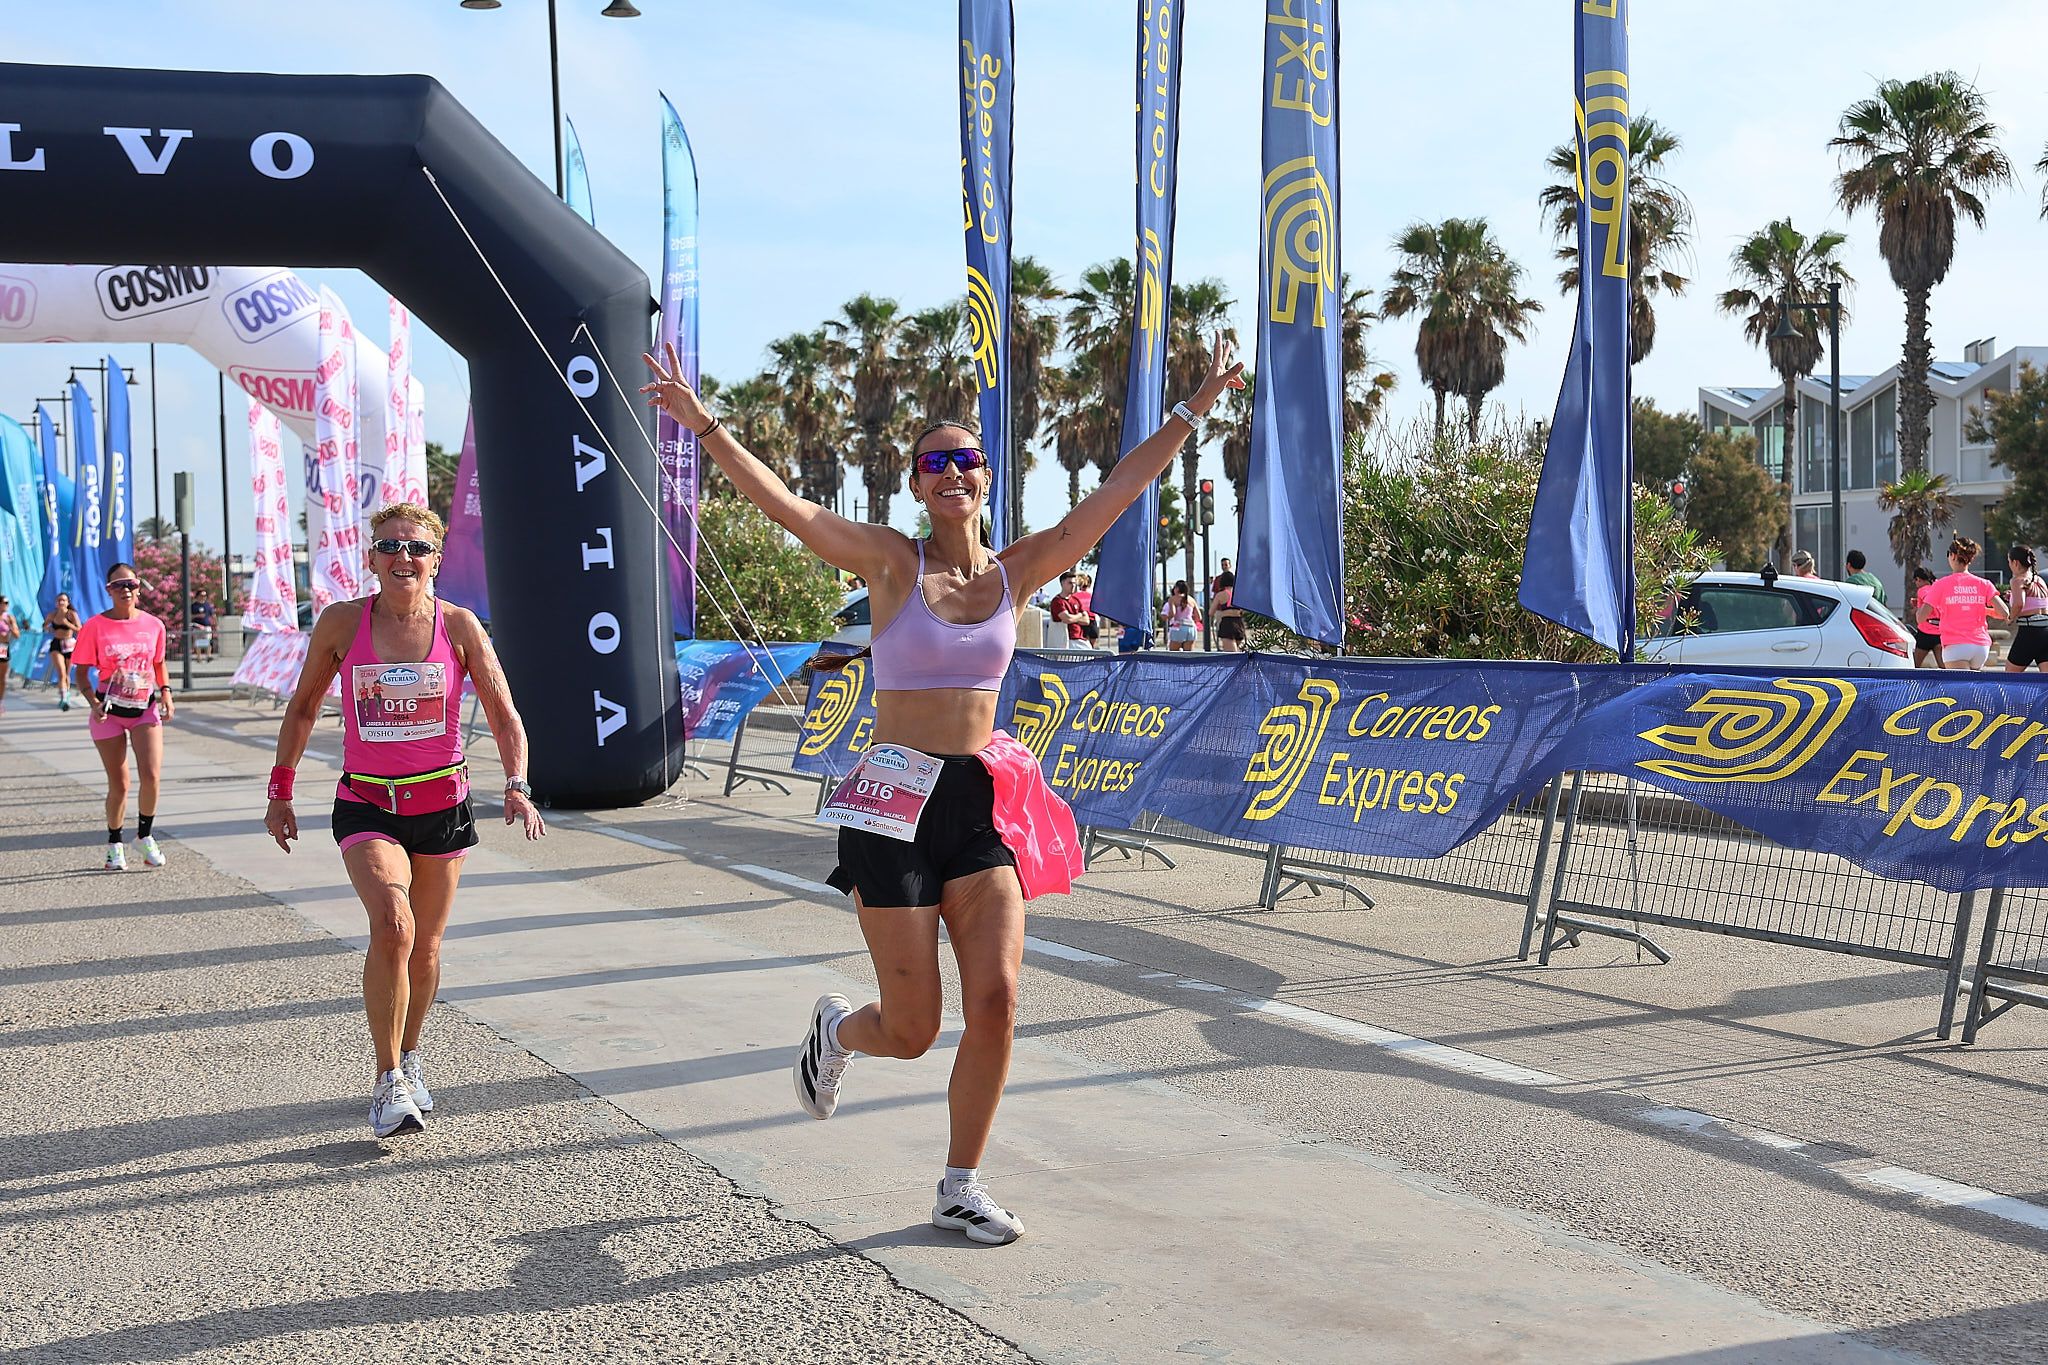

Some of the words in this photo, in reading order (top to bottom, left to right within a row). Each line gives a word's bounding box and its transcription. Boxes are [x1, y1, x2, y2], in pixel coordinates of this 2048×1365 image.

[239, 372, 318, 413] COSM
[566, 355, 628, 747] VOLVO
[1954, 586, 1978, 594] SOMOS
[382, 675, 417, 683] ASTURIANA
[384, 699, 418, 712] 016
[1071, 690, 1171, 738] Correos
[1347, 692, 1502, 741] Correos
[410, 728, 437, 736] Santander
[1051, 743, 1142, 800] Express
[856, 779, 895, 800] 016
[1318, 752, 1466, 823] Express
[1815, 750, 2048, 848] Expres
[825, 811, 855, 821] OYSHO
[871, 820, 904, 833] Santander
[883, 811, 907, 821] VALENCIA
